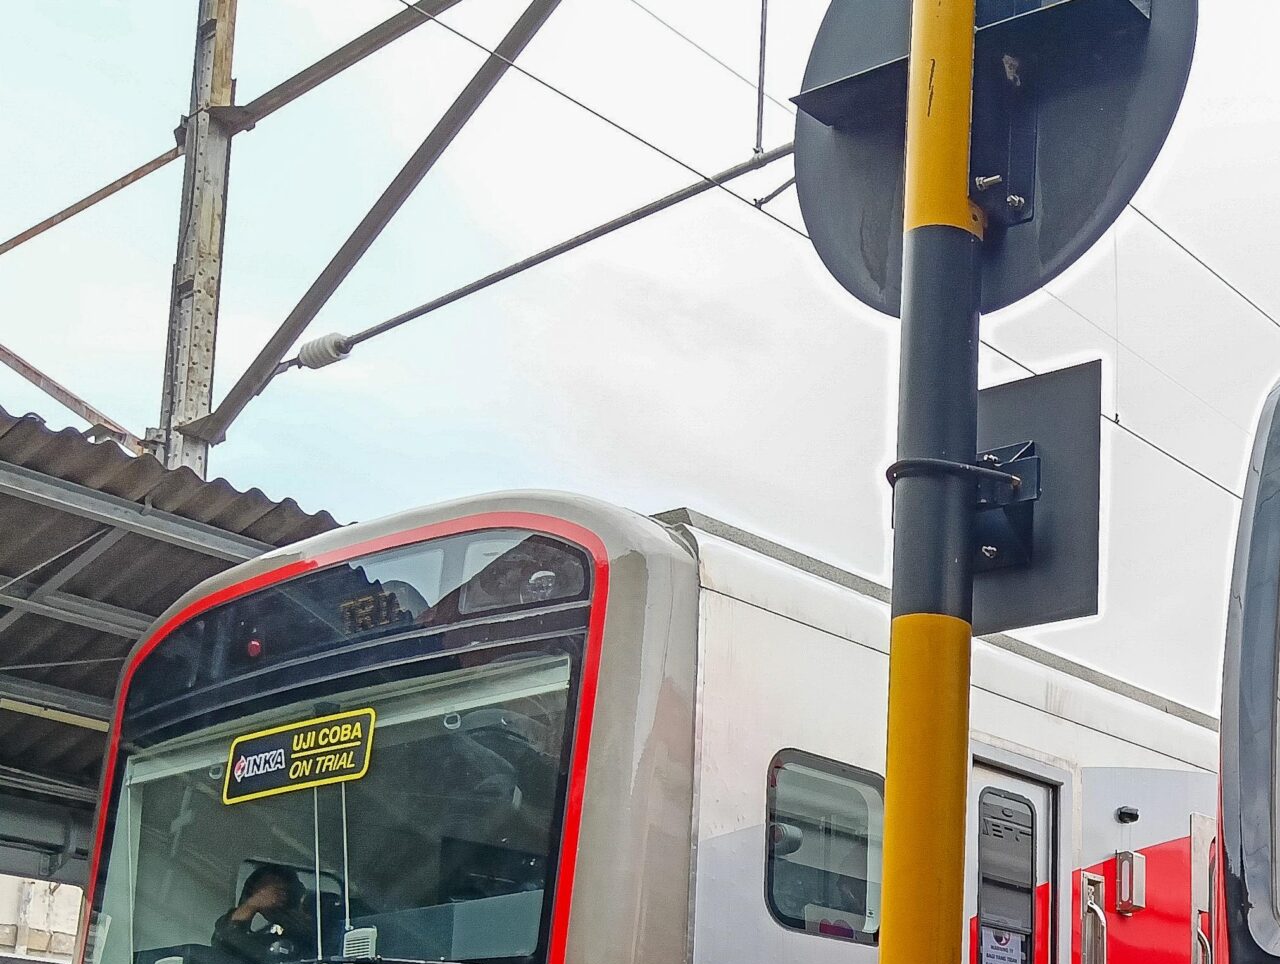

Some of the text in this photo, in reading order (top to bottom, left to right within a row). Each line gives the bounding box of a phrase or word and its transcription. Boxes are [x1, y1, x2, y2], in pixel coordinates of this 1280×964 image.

[291, 721, 363, 752] UJI COBA
[244, 748, 286, 778] INKA
[288, 750, 356, 780] ON TRIAL
